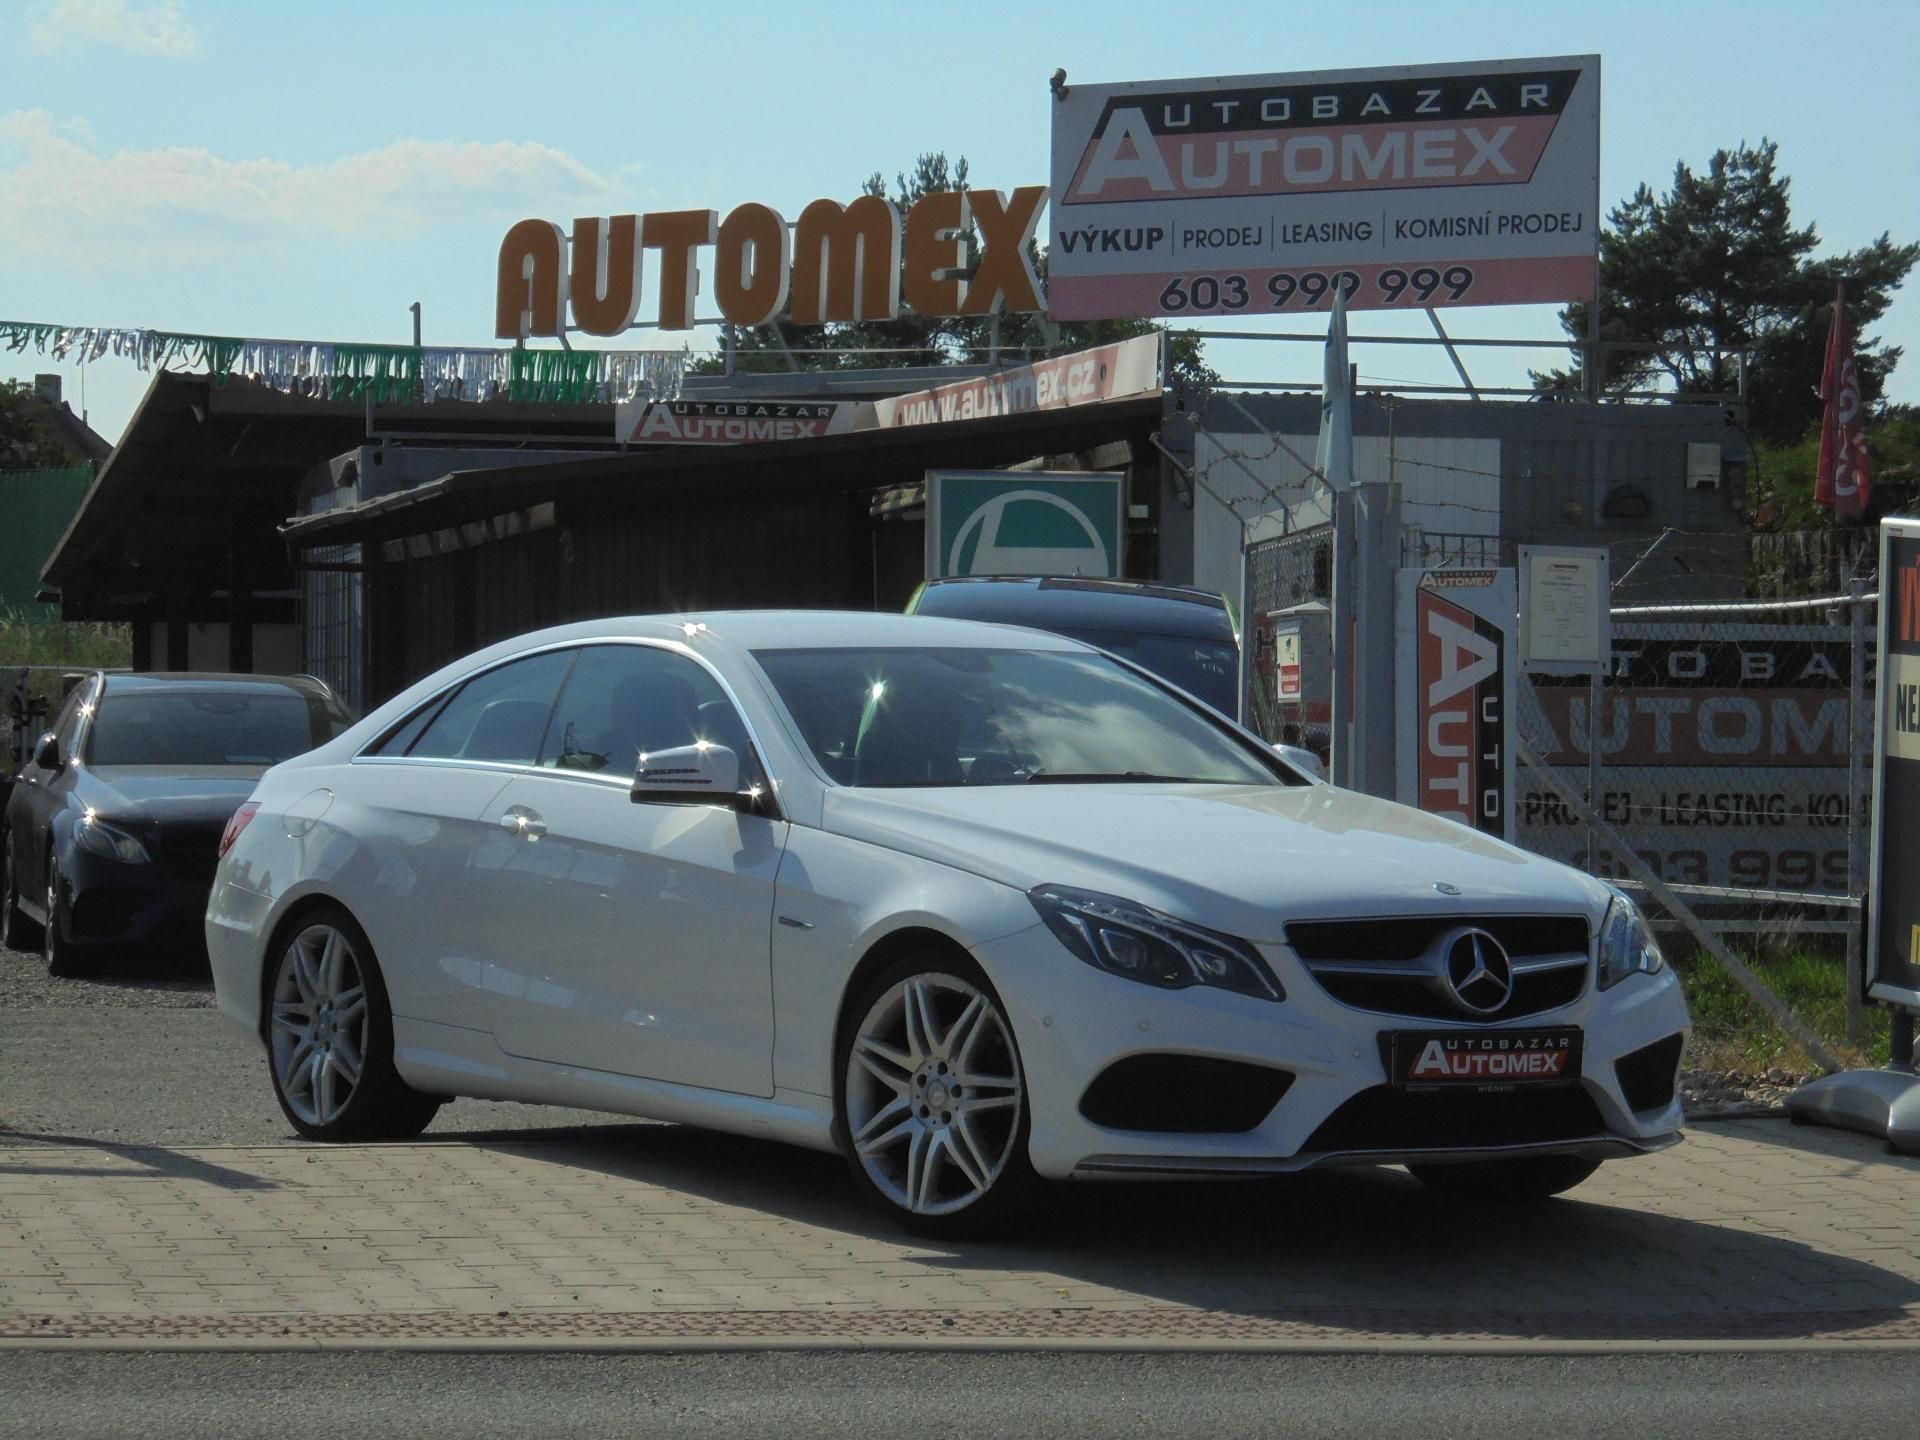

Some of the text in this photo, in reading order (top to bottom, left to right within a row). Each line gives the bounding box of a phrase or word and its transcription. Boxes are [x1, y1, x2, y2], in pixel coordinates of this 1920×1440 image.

[1077, 107, 1518, 195] AUTOMEX
[1059, 210, 1583, 253] VÝKUP PRODEJ LEASING KOMISNÍ PRODEJ
[495, 186, 1050, 339] AUTOMEX
[1160, 265, 1474, 312] 603 999 999
[639, 403, 818, 440] AUTOMEX
[1420, 572, 1492, 588] AUTOMEX
[1428, 610, 1498, 832] AUT
[1526, 792, 1631, 826] PROEJ
[1661, 793, 1786, 827] LEASING
[1414, 1040, 1560, 1074] AUTOMEX
